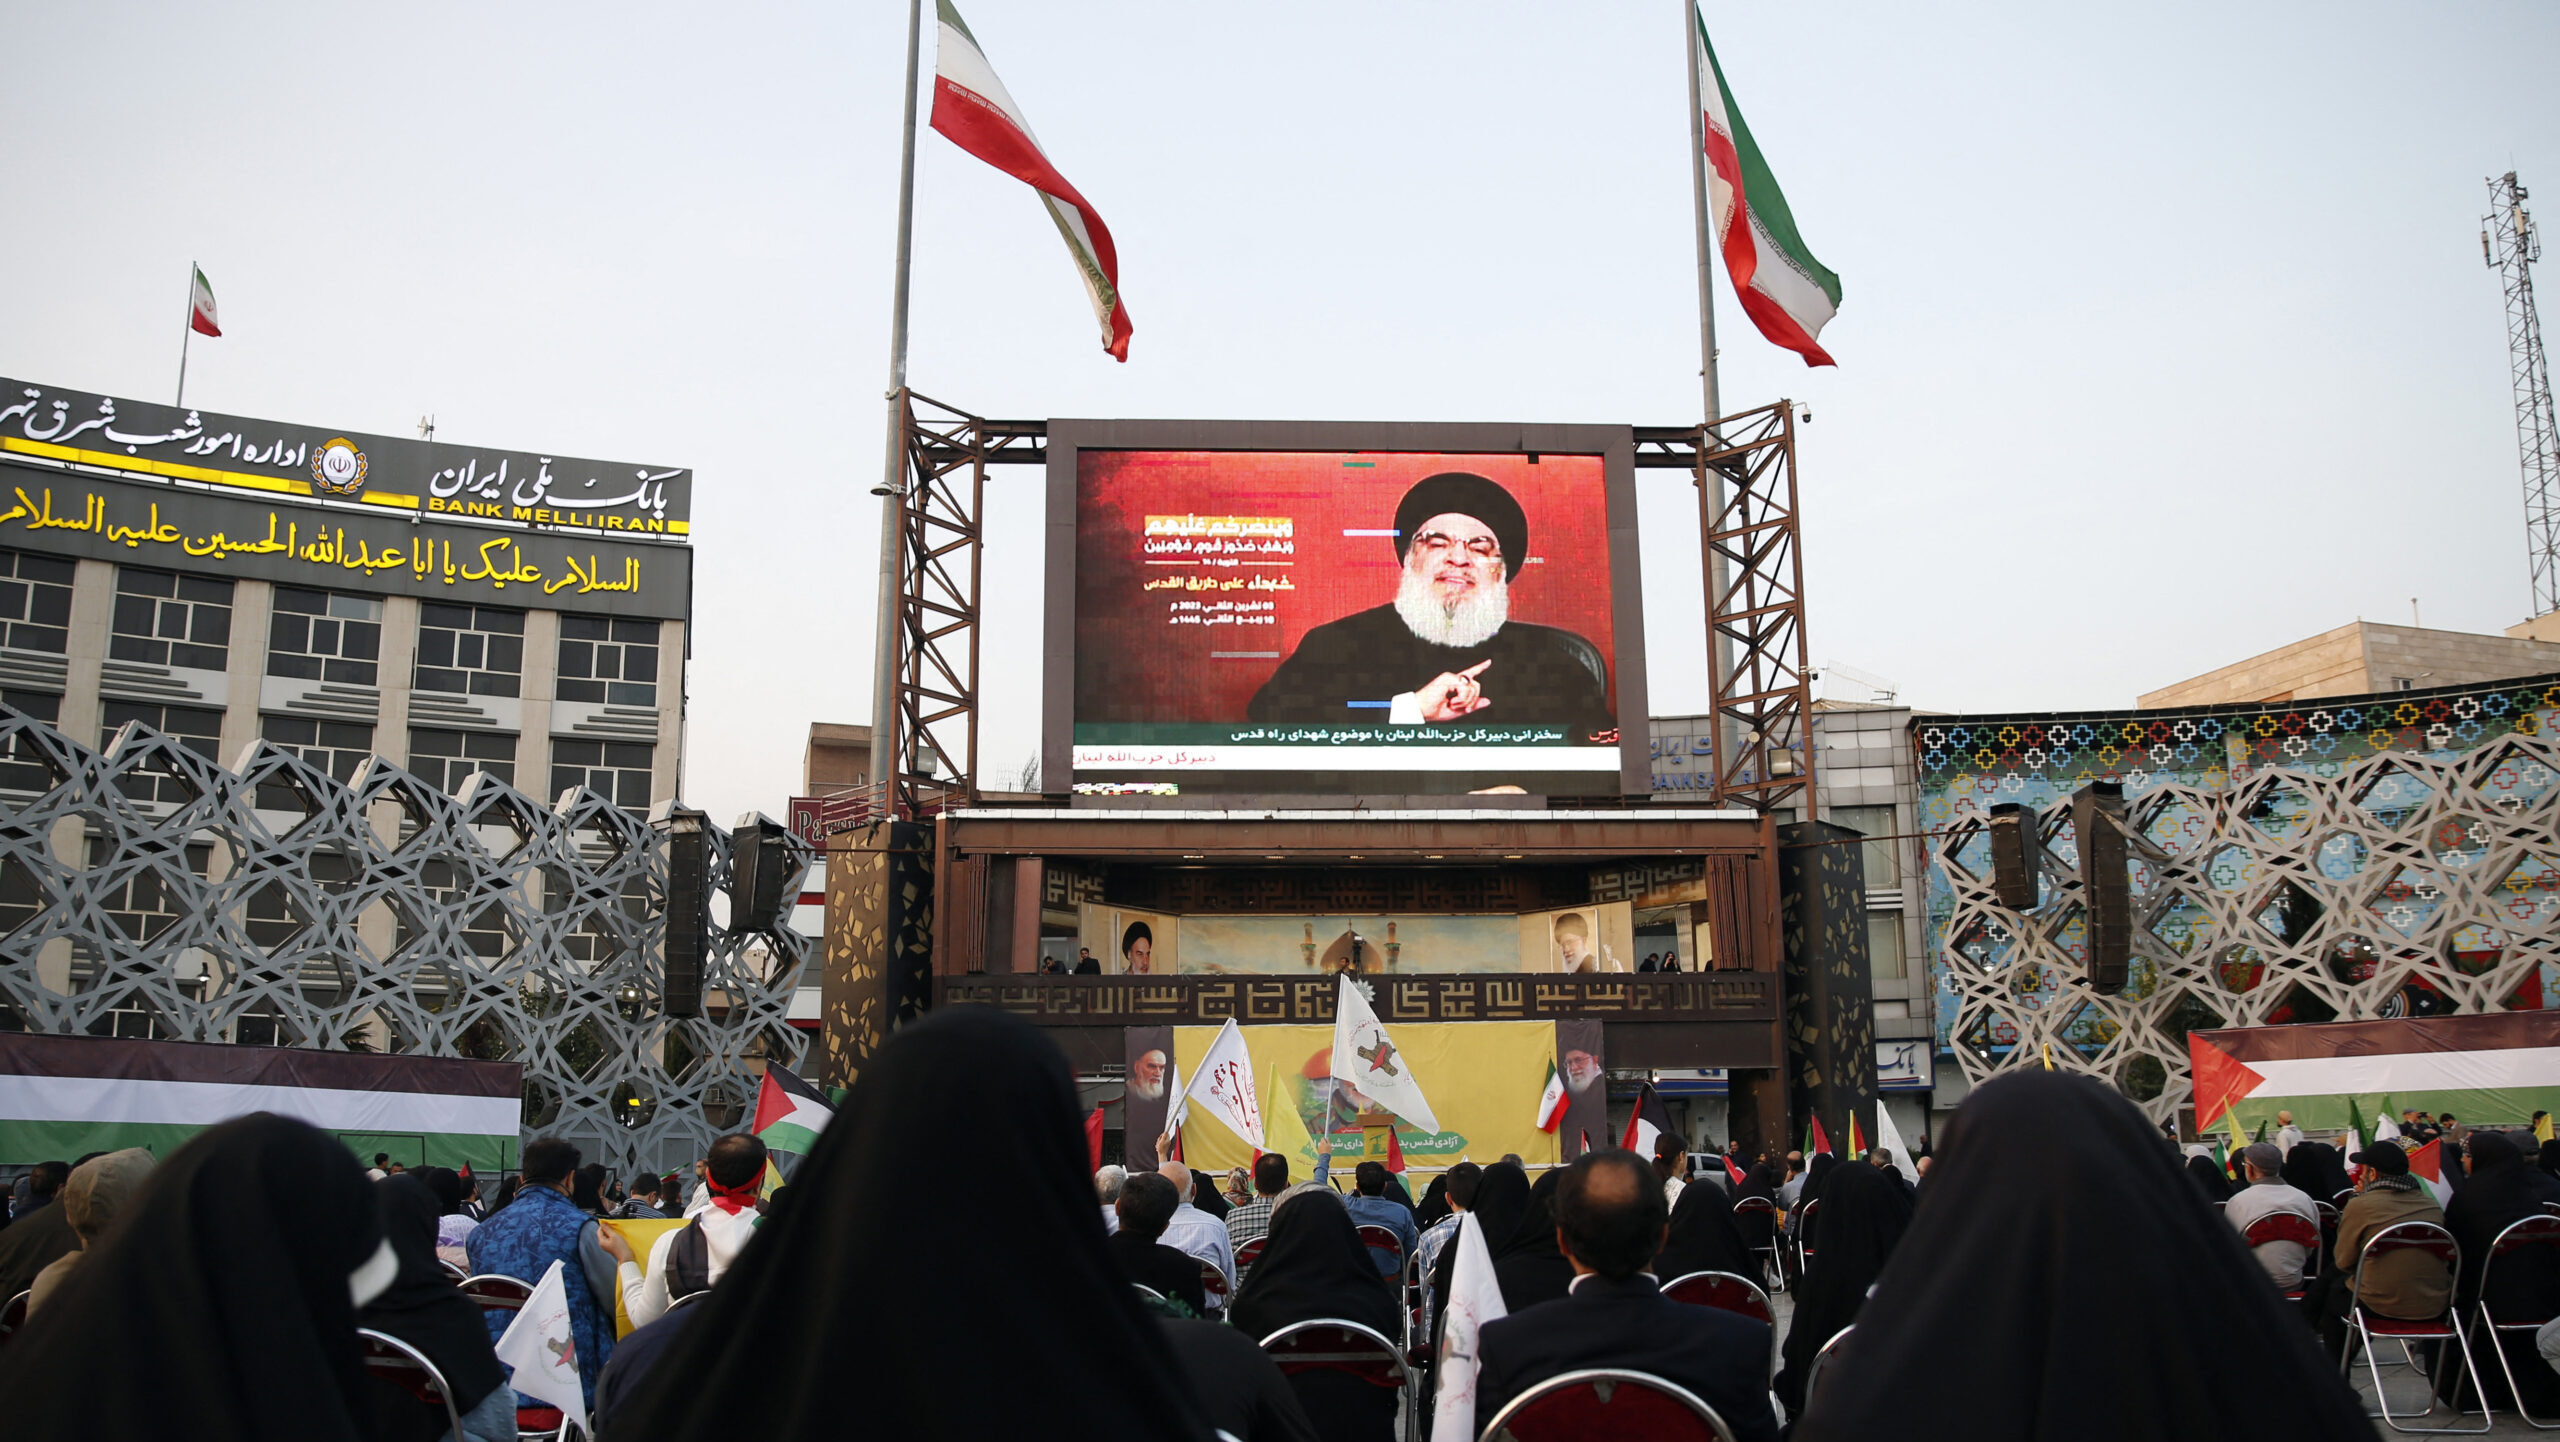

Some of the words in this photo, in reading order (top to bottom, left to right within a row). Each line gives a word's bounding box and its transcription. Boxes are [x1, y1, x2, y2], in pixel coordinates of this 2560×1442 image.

[0, 387, 42, 424] تهر
[23, 397, 116, 443] شرق
[104, 410, 203, 455] شعب
[184, 431, 243, 459] امور
[243, 438, 306, 467] اداره
[429, 457, 507, 499] ایران
[545, 468, 684, 520] بانک
[106, 501, 181, 548] علیه
[428, 496, 503, 519] BANK
[511, 505, 593, 528] MELLI
[597, 513, 664, 533] IRAN
[183, 511, 296, 560] الحسین
[412, 536, 434, 582] ابا
[442, 539, 456, 585] یا
[543, 554, 640, 594] السلام
[1230, 728, 1266, 742] قدس
[1267, 729, 1286, 742] راه
[1288, 728, 1329, 742] شهدای
[1330, 729, 1372, 744] موضوع
[1374, 729, 1384, 742] با
[1386, 728, 1415, 743] لبنان
[1469, 728, 1511, 743] دبیرکل
[1512, 728, 1563, 743] سخنرانی
[1409, 1136, 1435, 1149] قدس
